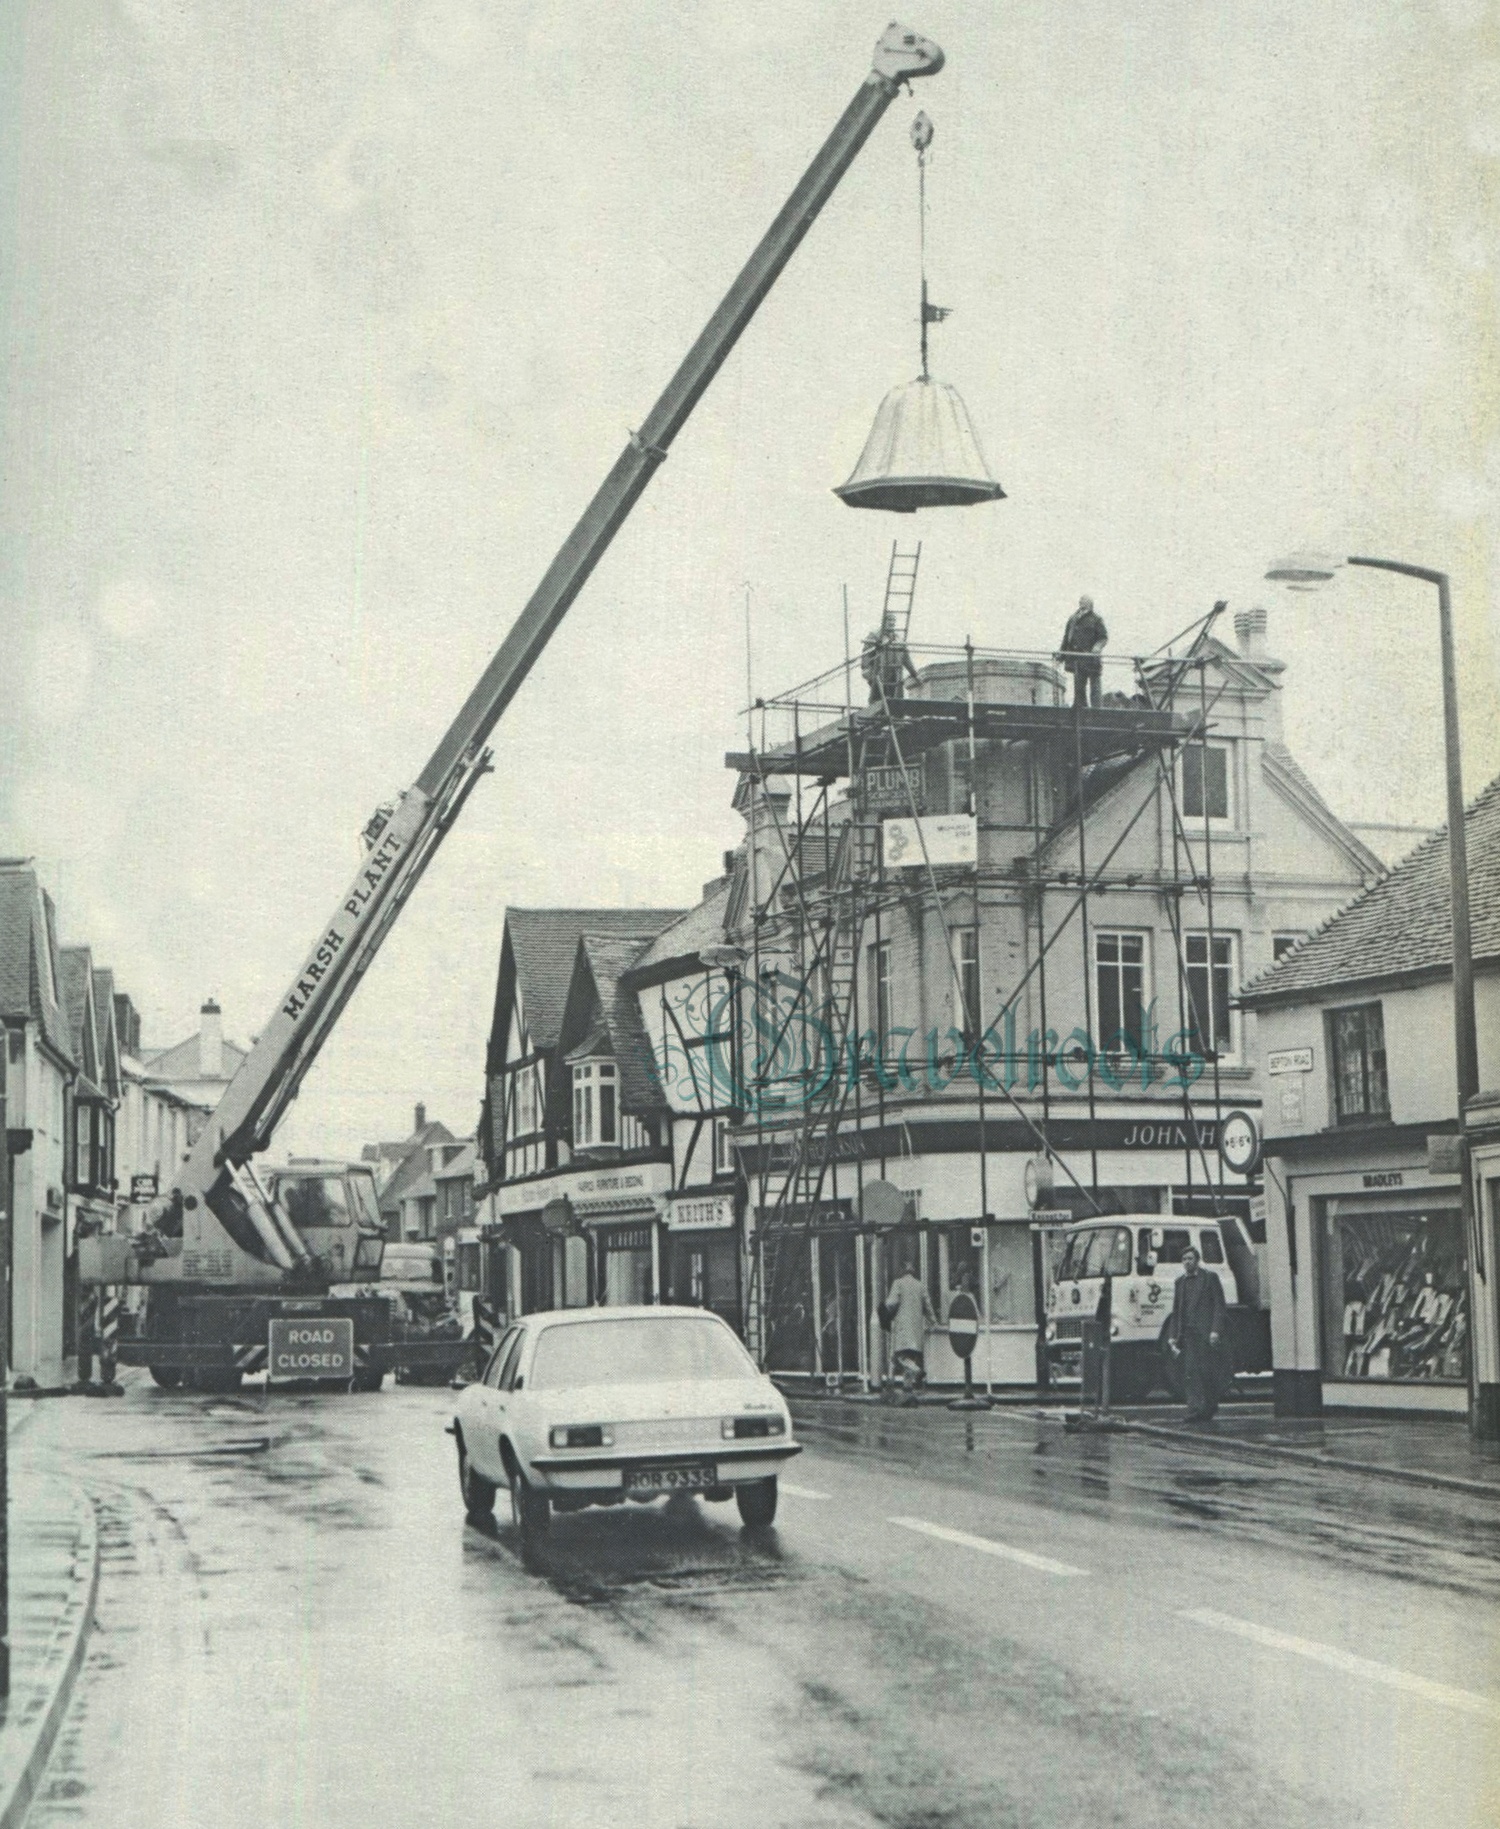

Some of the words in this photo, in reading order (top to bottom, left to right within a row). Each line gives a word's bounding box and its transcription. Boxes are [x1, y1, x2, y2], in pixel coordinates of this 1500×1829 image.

[283, 929, 344, 1021] MARSH
[344, 832, 401, 919] PLANT
[1123, 1126, 1188, 1146] JOHN
[288, 1329, 335, 1345] ROAD
[277, 1352, 344, 1369] CLOSED
